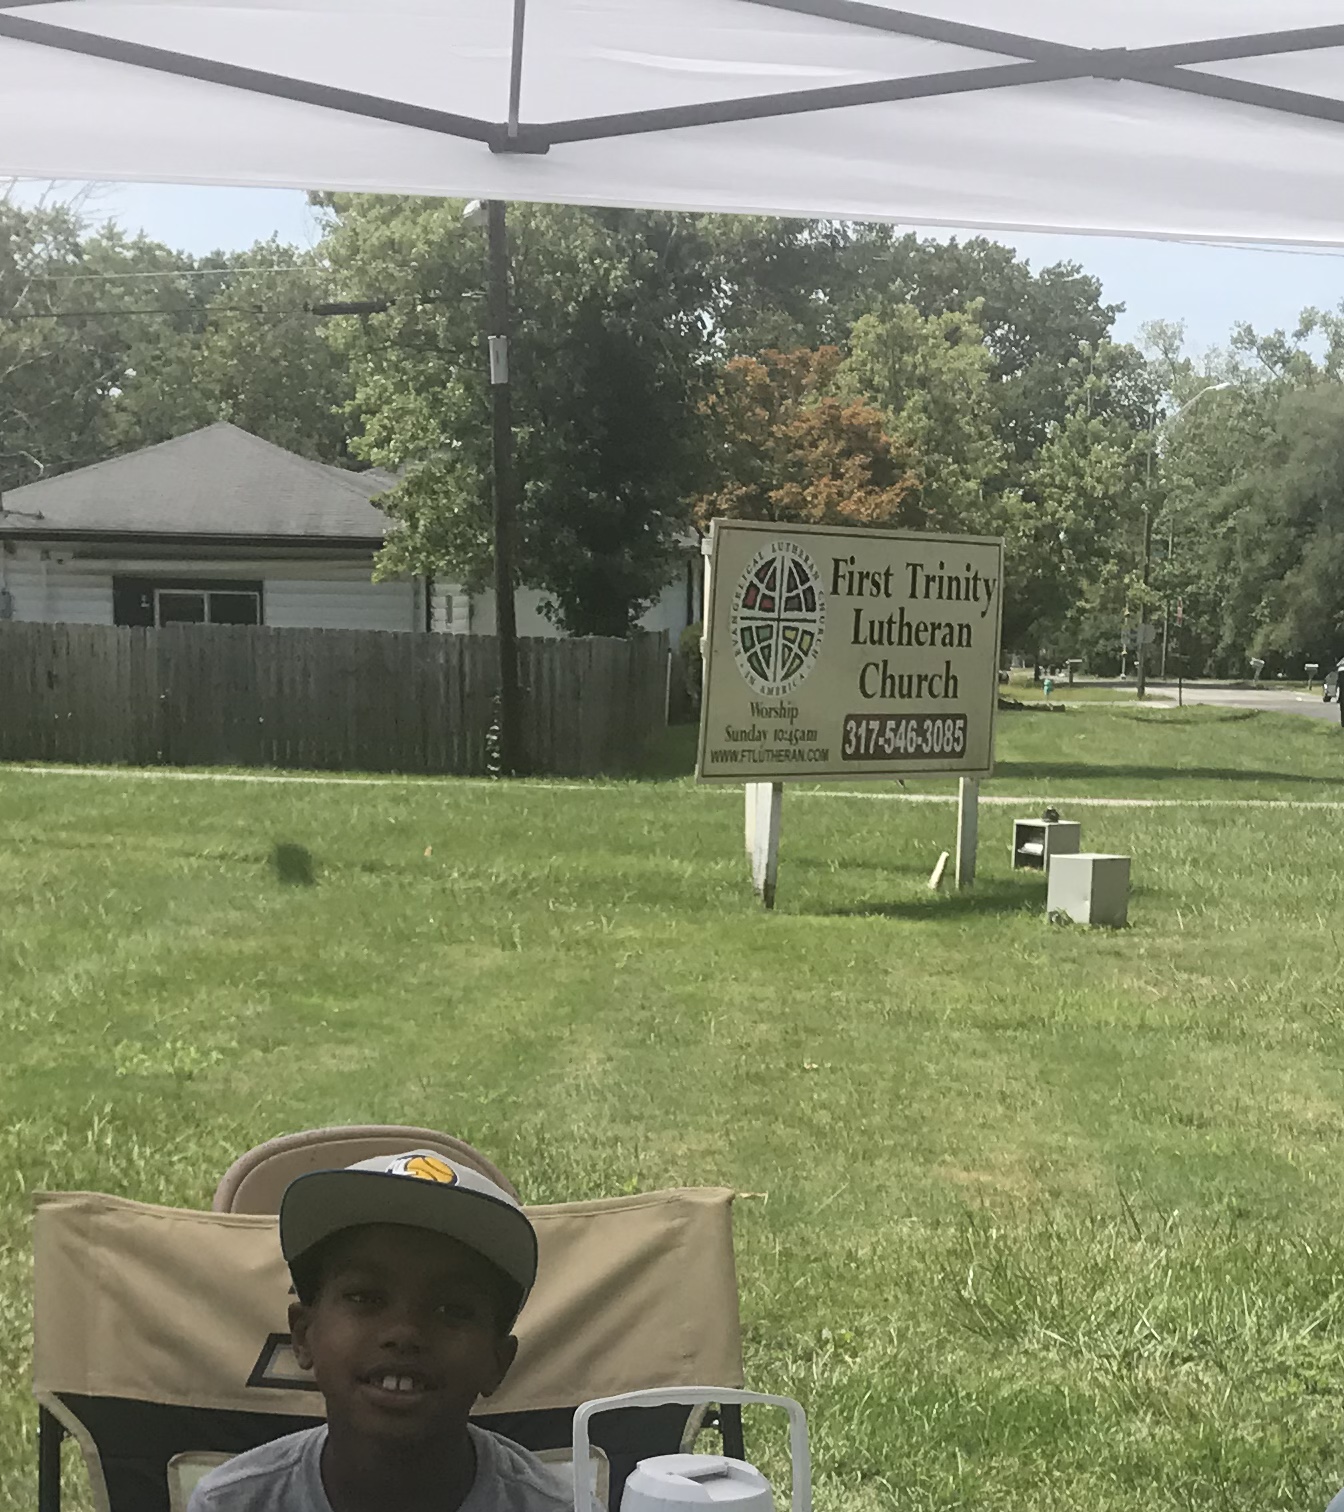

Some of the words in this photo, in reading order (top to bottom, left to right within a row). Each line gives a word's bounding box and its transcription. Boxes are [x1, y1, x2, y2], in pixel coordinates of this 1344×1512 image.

[830, 555, 894, 598] First
[906, 561, 997, 618] Trinity
[851, 606, 972, 648] Lutheran
[859, 659, 958, 699] Church
[750, 700, 799, 725] Worship
[725, 724, 768, 749] Sunday
[774, 729, 817, 746] 10:45am
[844, 719, 965, 754] 317-546-3085
[711, 748, 829, 763] WWW.FTLUTHERAN.COM
